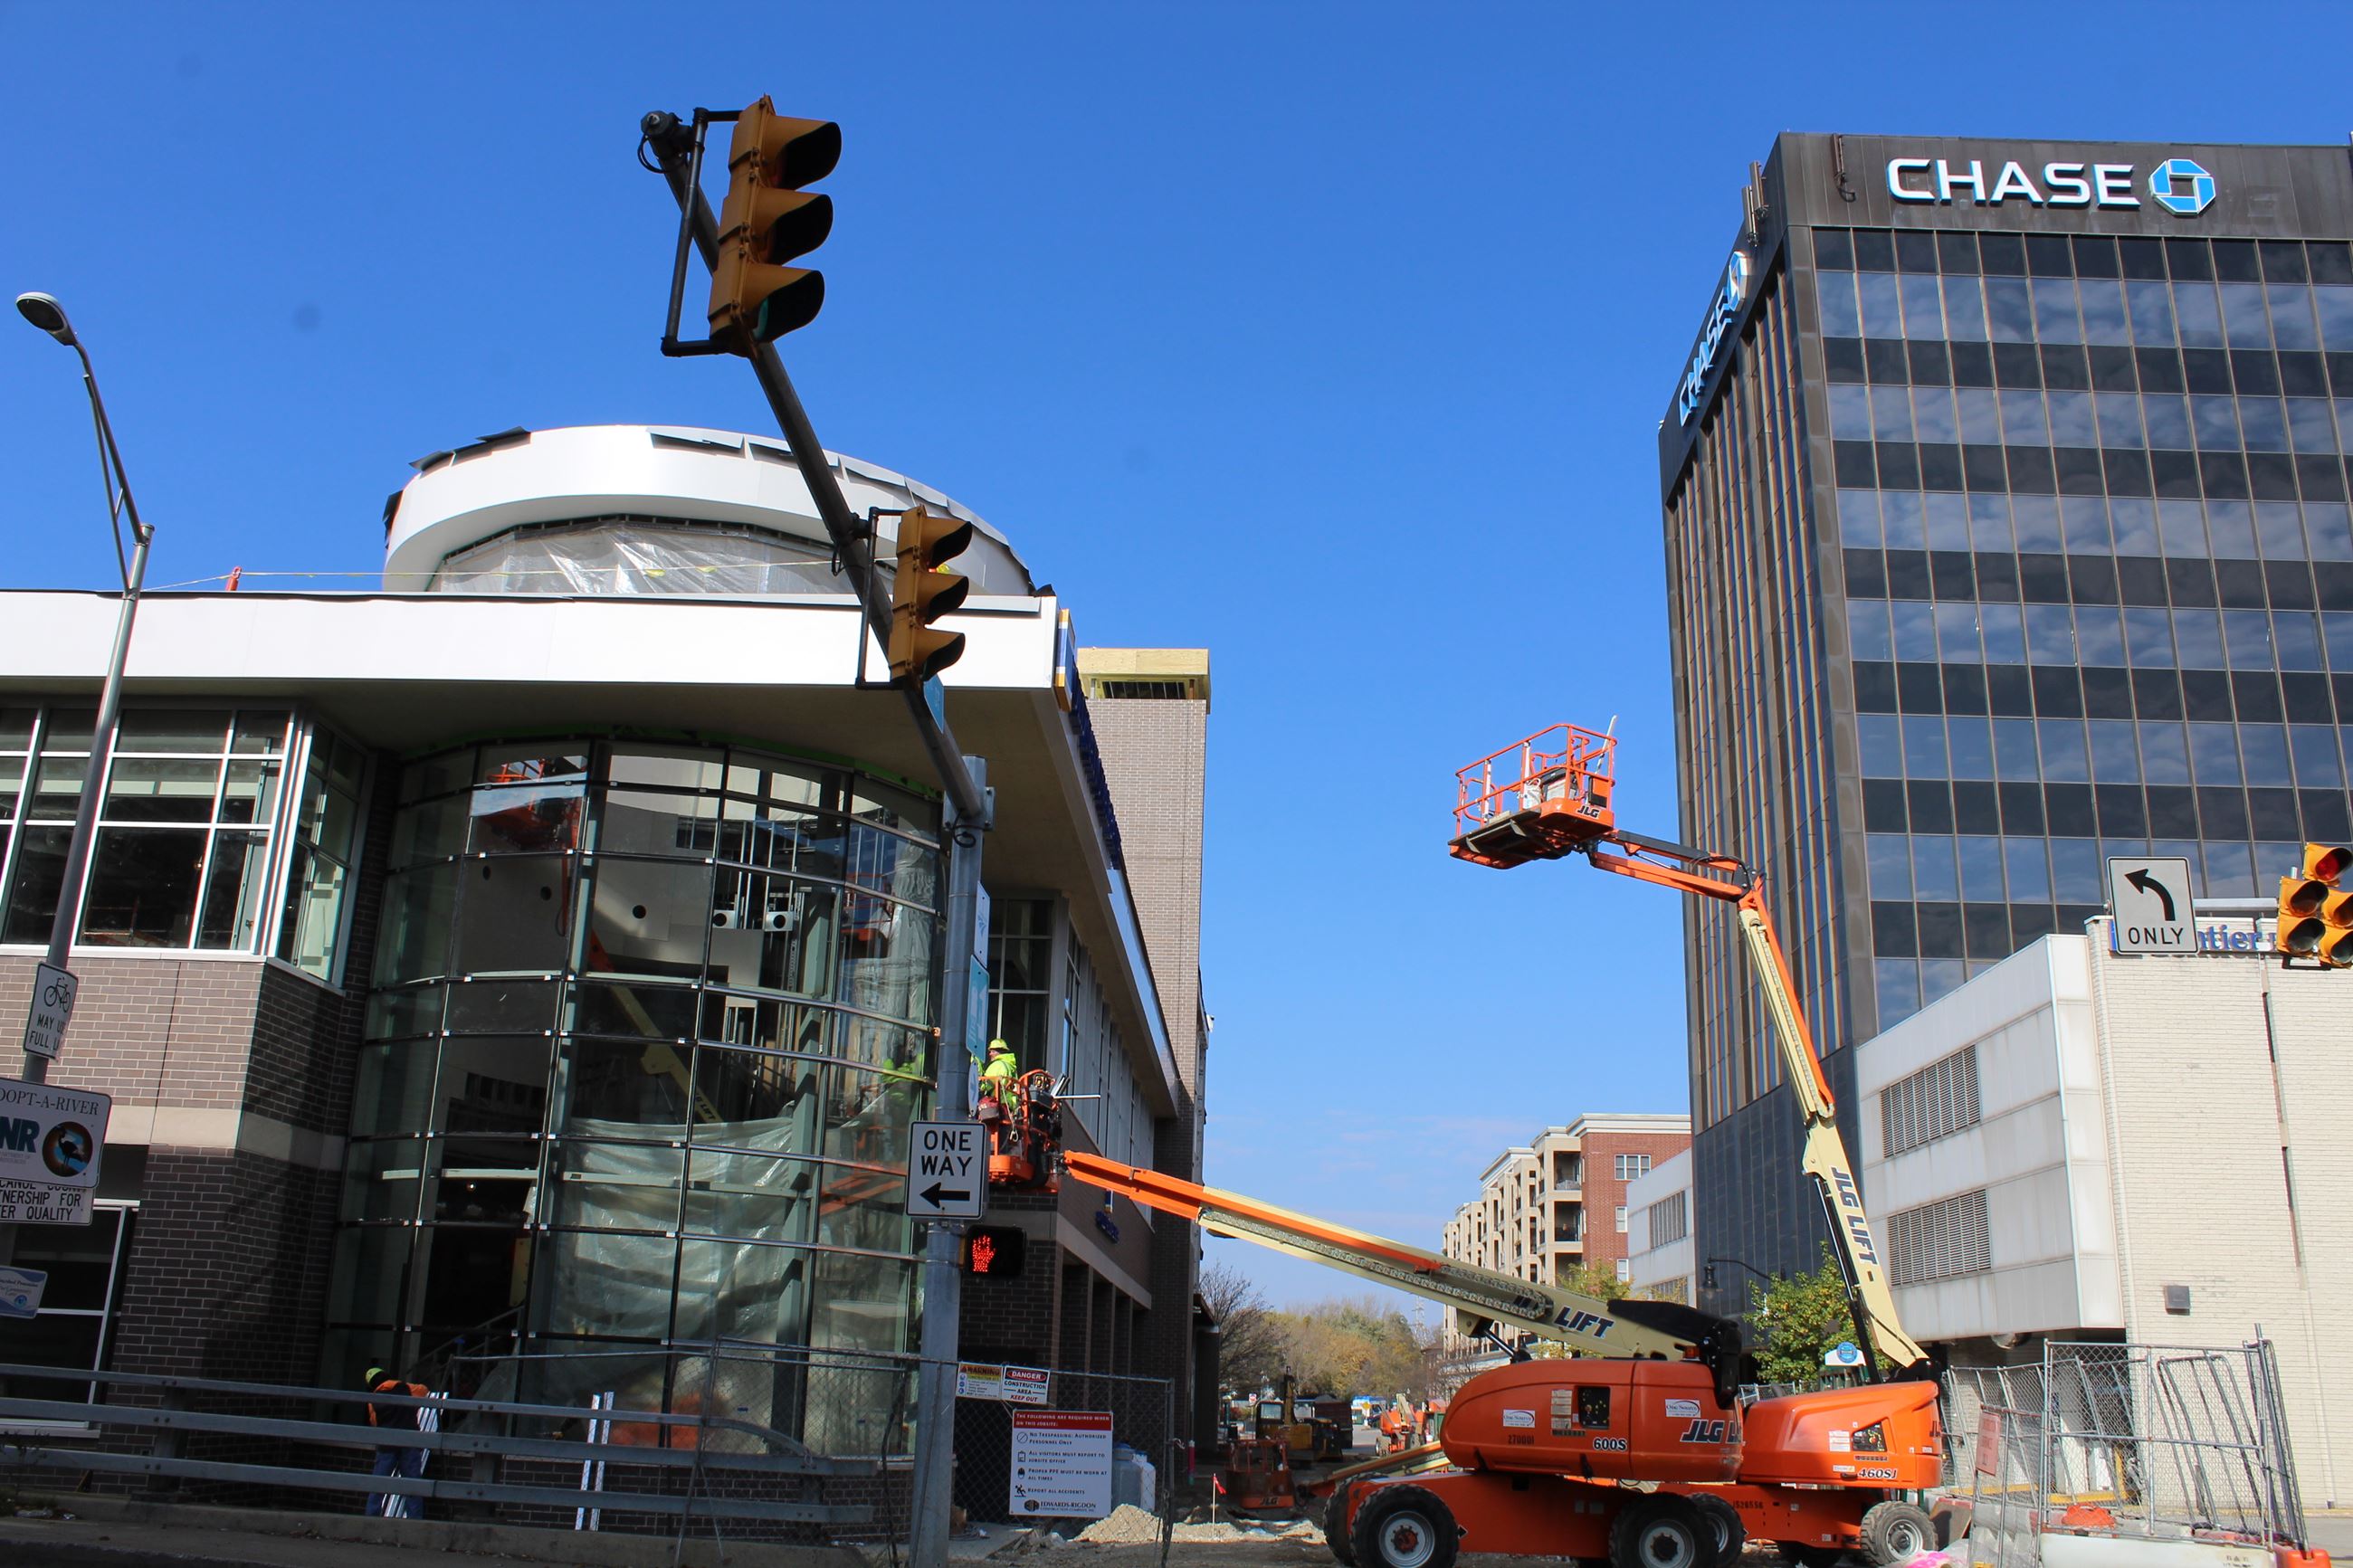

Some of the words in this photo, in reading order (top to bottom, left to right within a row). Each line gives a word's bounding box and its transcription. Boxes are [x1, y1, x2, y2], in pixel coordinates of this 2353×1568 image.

[1886, 157, 2141, 211] CHASE
[1679, 287, 1733, 428] CHASE
[1577, 805, 1600, 819] JLG
[2128, 927, 2185, 945] ONLY
[37, 1013, 54, 1031] MAY
[29, 1031, 49, 1049] FULL
[924, 1130, 972, 1151] ONE
[921, 1155, 973, 1176] WAY
[1830, 1165, 1861, 1209] JLG
[60, 1193, 81, 1207] FOR
[0, 1205, 15, 1219] ER
[26, 1206, 72, 1221] QUALITY
[1845, 1213, 1879, 1266] LIFT
[1553, 1306, 1615, 1338] LIFT
[1012, 1371, 1041, 1380] DANGER
[1004, 1381, 1046, 1390] CONSTRUCTION
[1680, 1419, 1725, 1443] JLG
[1593, 1436, 1628, 1451] 600S
[1858, 1468, 1898, 1480] 460SJ
